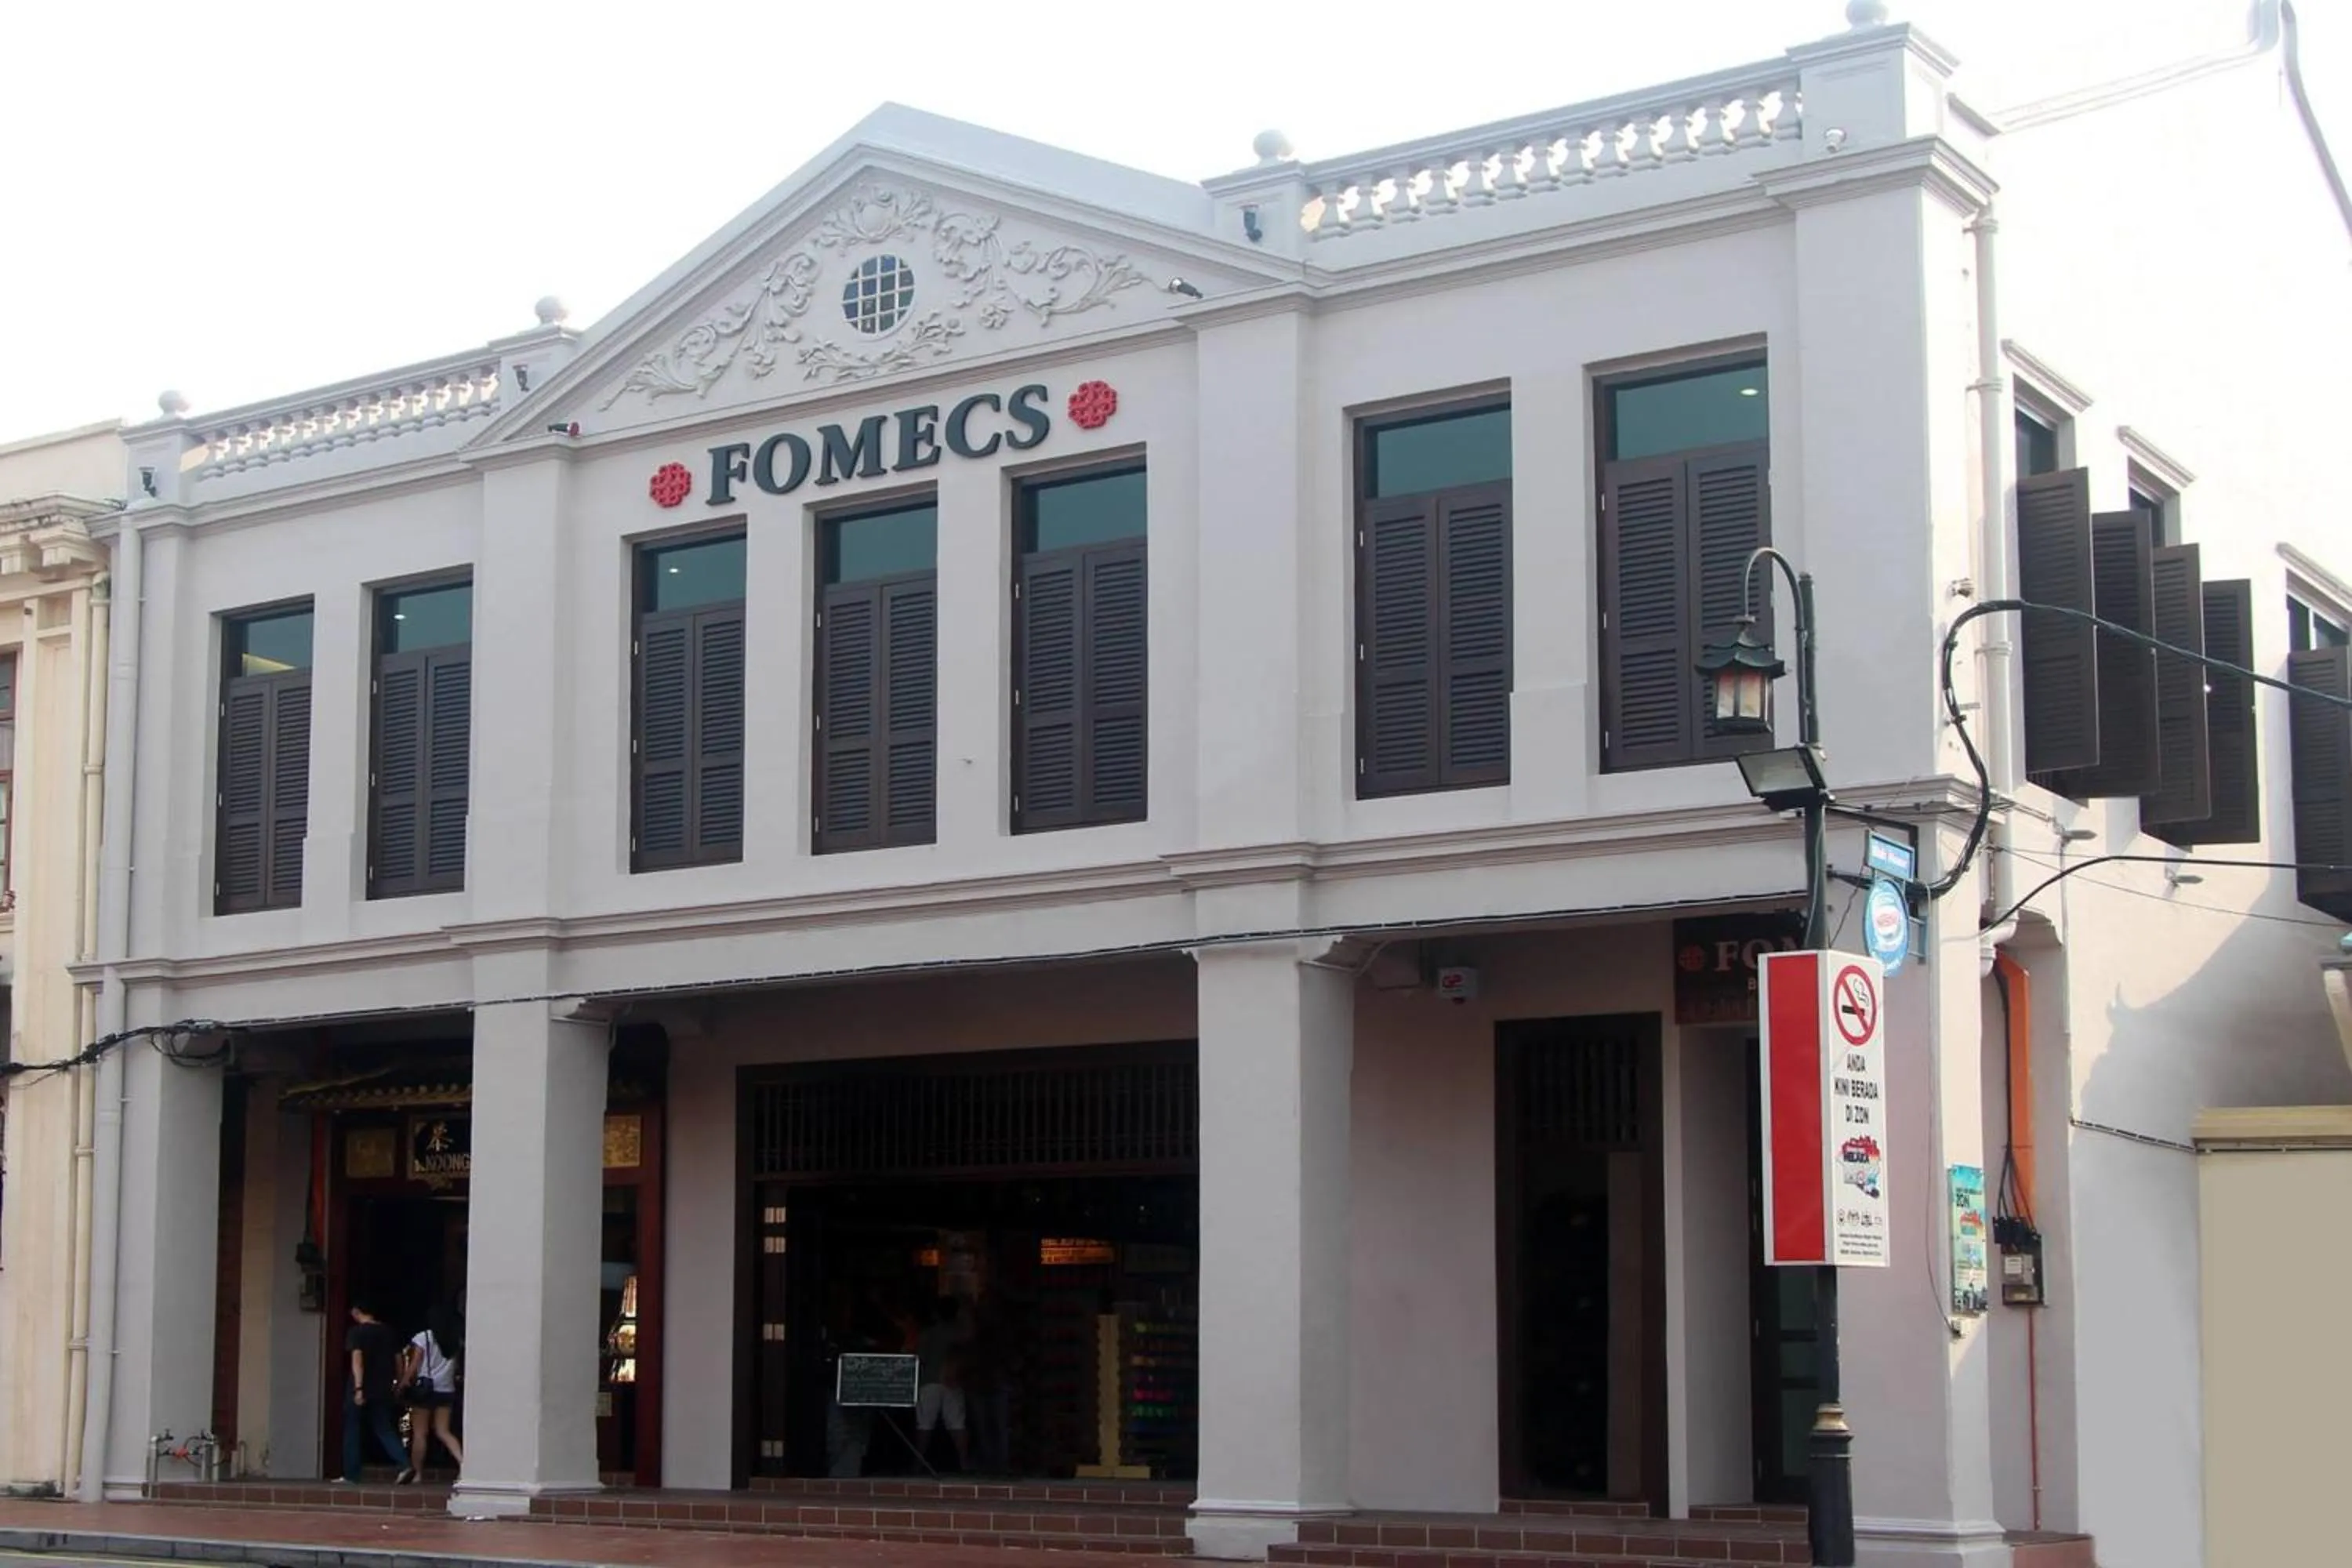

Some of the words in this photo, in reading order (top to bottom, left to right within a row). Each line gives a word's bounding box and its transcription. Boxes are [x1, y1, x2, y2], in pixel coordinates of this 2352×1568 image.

[705, 383, 1051, 506] FOMECS
[1846, 1053, 1866, 1072] ANDA
[1851, 1079, 1878, 1099] BERADA
[1854, 1105, 1870, 1123] ZON
